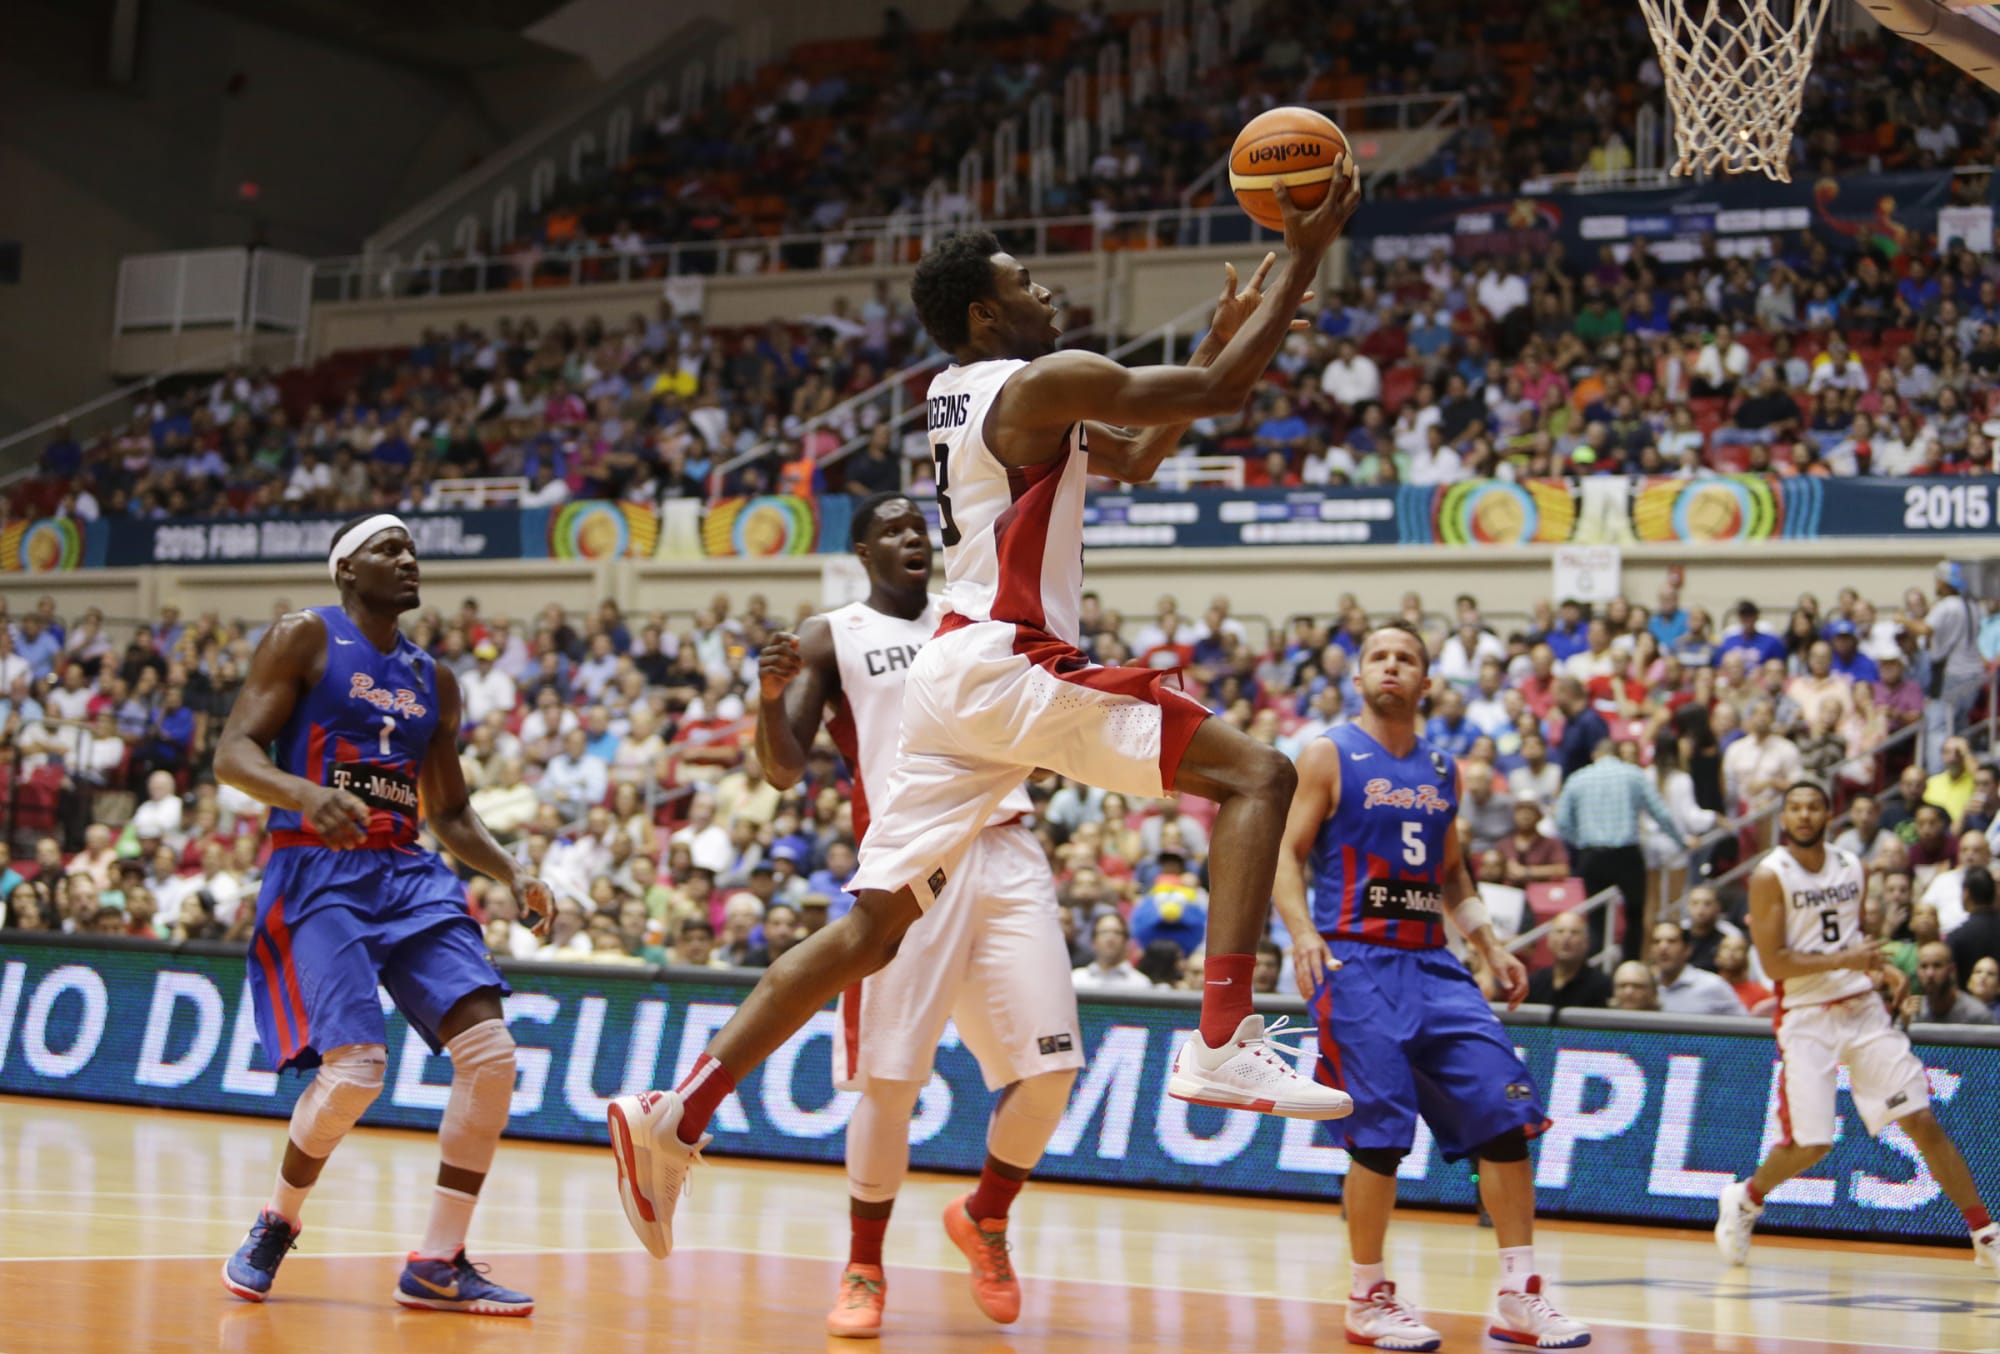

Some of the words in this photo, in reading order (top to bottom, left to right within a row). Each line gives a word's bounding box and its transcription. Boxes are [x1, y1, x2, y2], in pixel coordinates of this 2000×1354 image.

[1250, 143, 1321, 164] molten
[928, 393, 971, 431] IGGINS
[1904, 485, 1990, 528] 2015
[864, 643, 923, 677] CAN
[379, 715, 396, 756] 1
[1401, 821, 1426, 867] 5
[1792, 881, 1859, 909] CANADA
[1821, 909, 1841, 943] 5
[375, 984, 958, 1146] EGUROS
[1044, 1025, 1962, 1210] MULPLES
